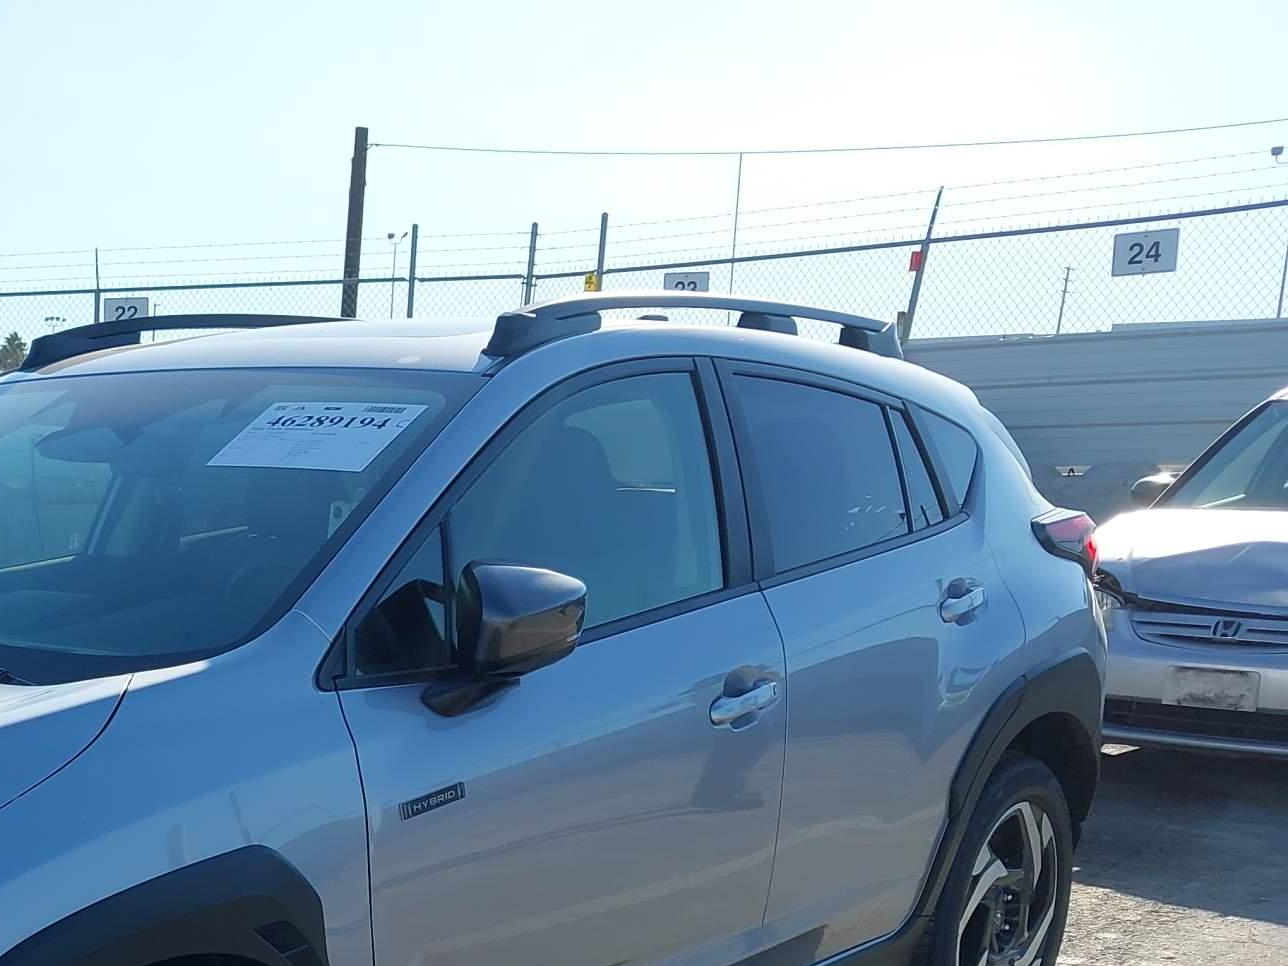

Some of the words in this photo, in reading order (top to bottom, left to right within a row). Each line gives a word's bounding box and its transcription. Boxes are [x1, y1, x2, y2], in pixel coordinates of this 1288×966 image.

[1127, 240, 1162, 265] 24
[266, 415, 391, 430] 46289194
[413, 790, 456, 812] HYBRID
